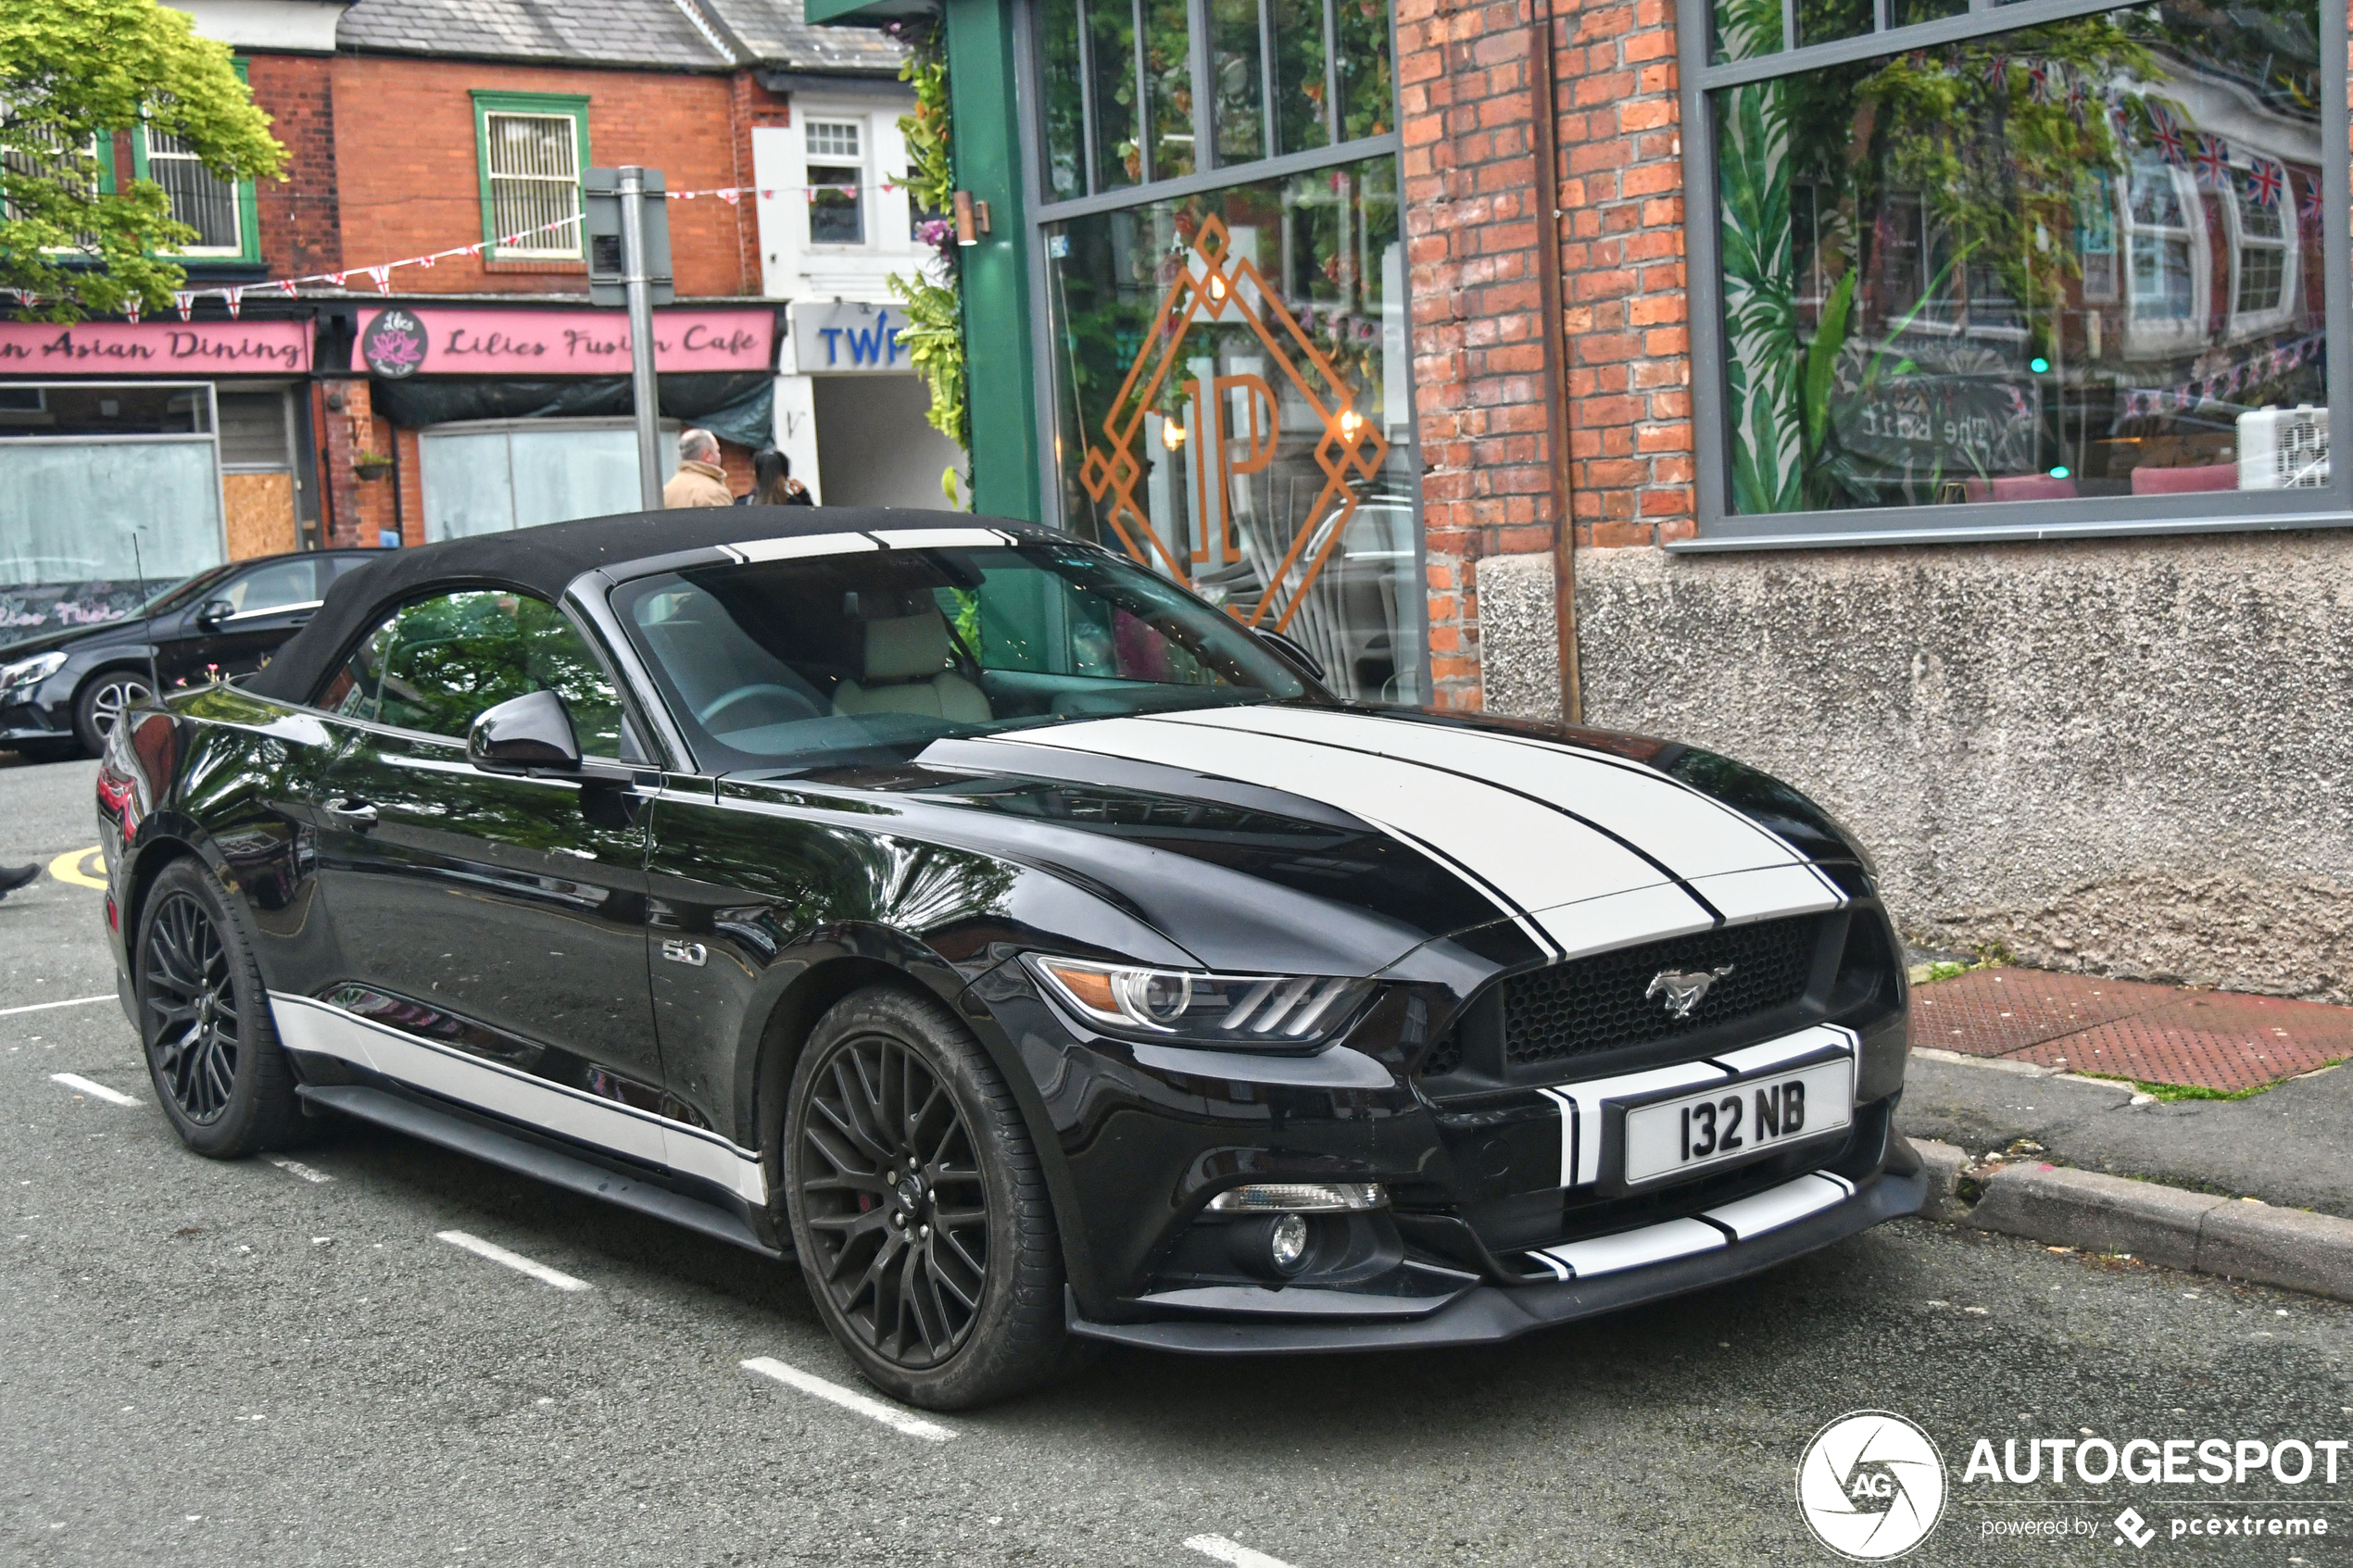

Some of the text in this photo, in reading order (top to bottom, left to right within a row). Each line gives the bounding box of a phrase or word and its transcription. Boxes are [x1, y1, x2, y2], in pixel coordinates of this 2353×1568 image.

[43, 332, 156, 359] Asian
[166, 332, 303, 368] Dining
[443, 329, 550, 357] Lilies
[563, 329, 673, 358] Fusin
[1680, 1079, 1806, 1161] 132 NB
